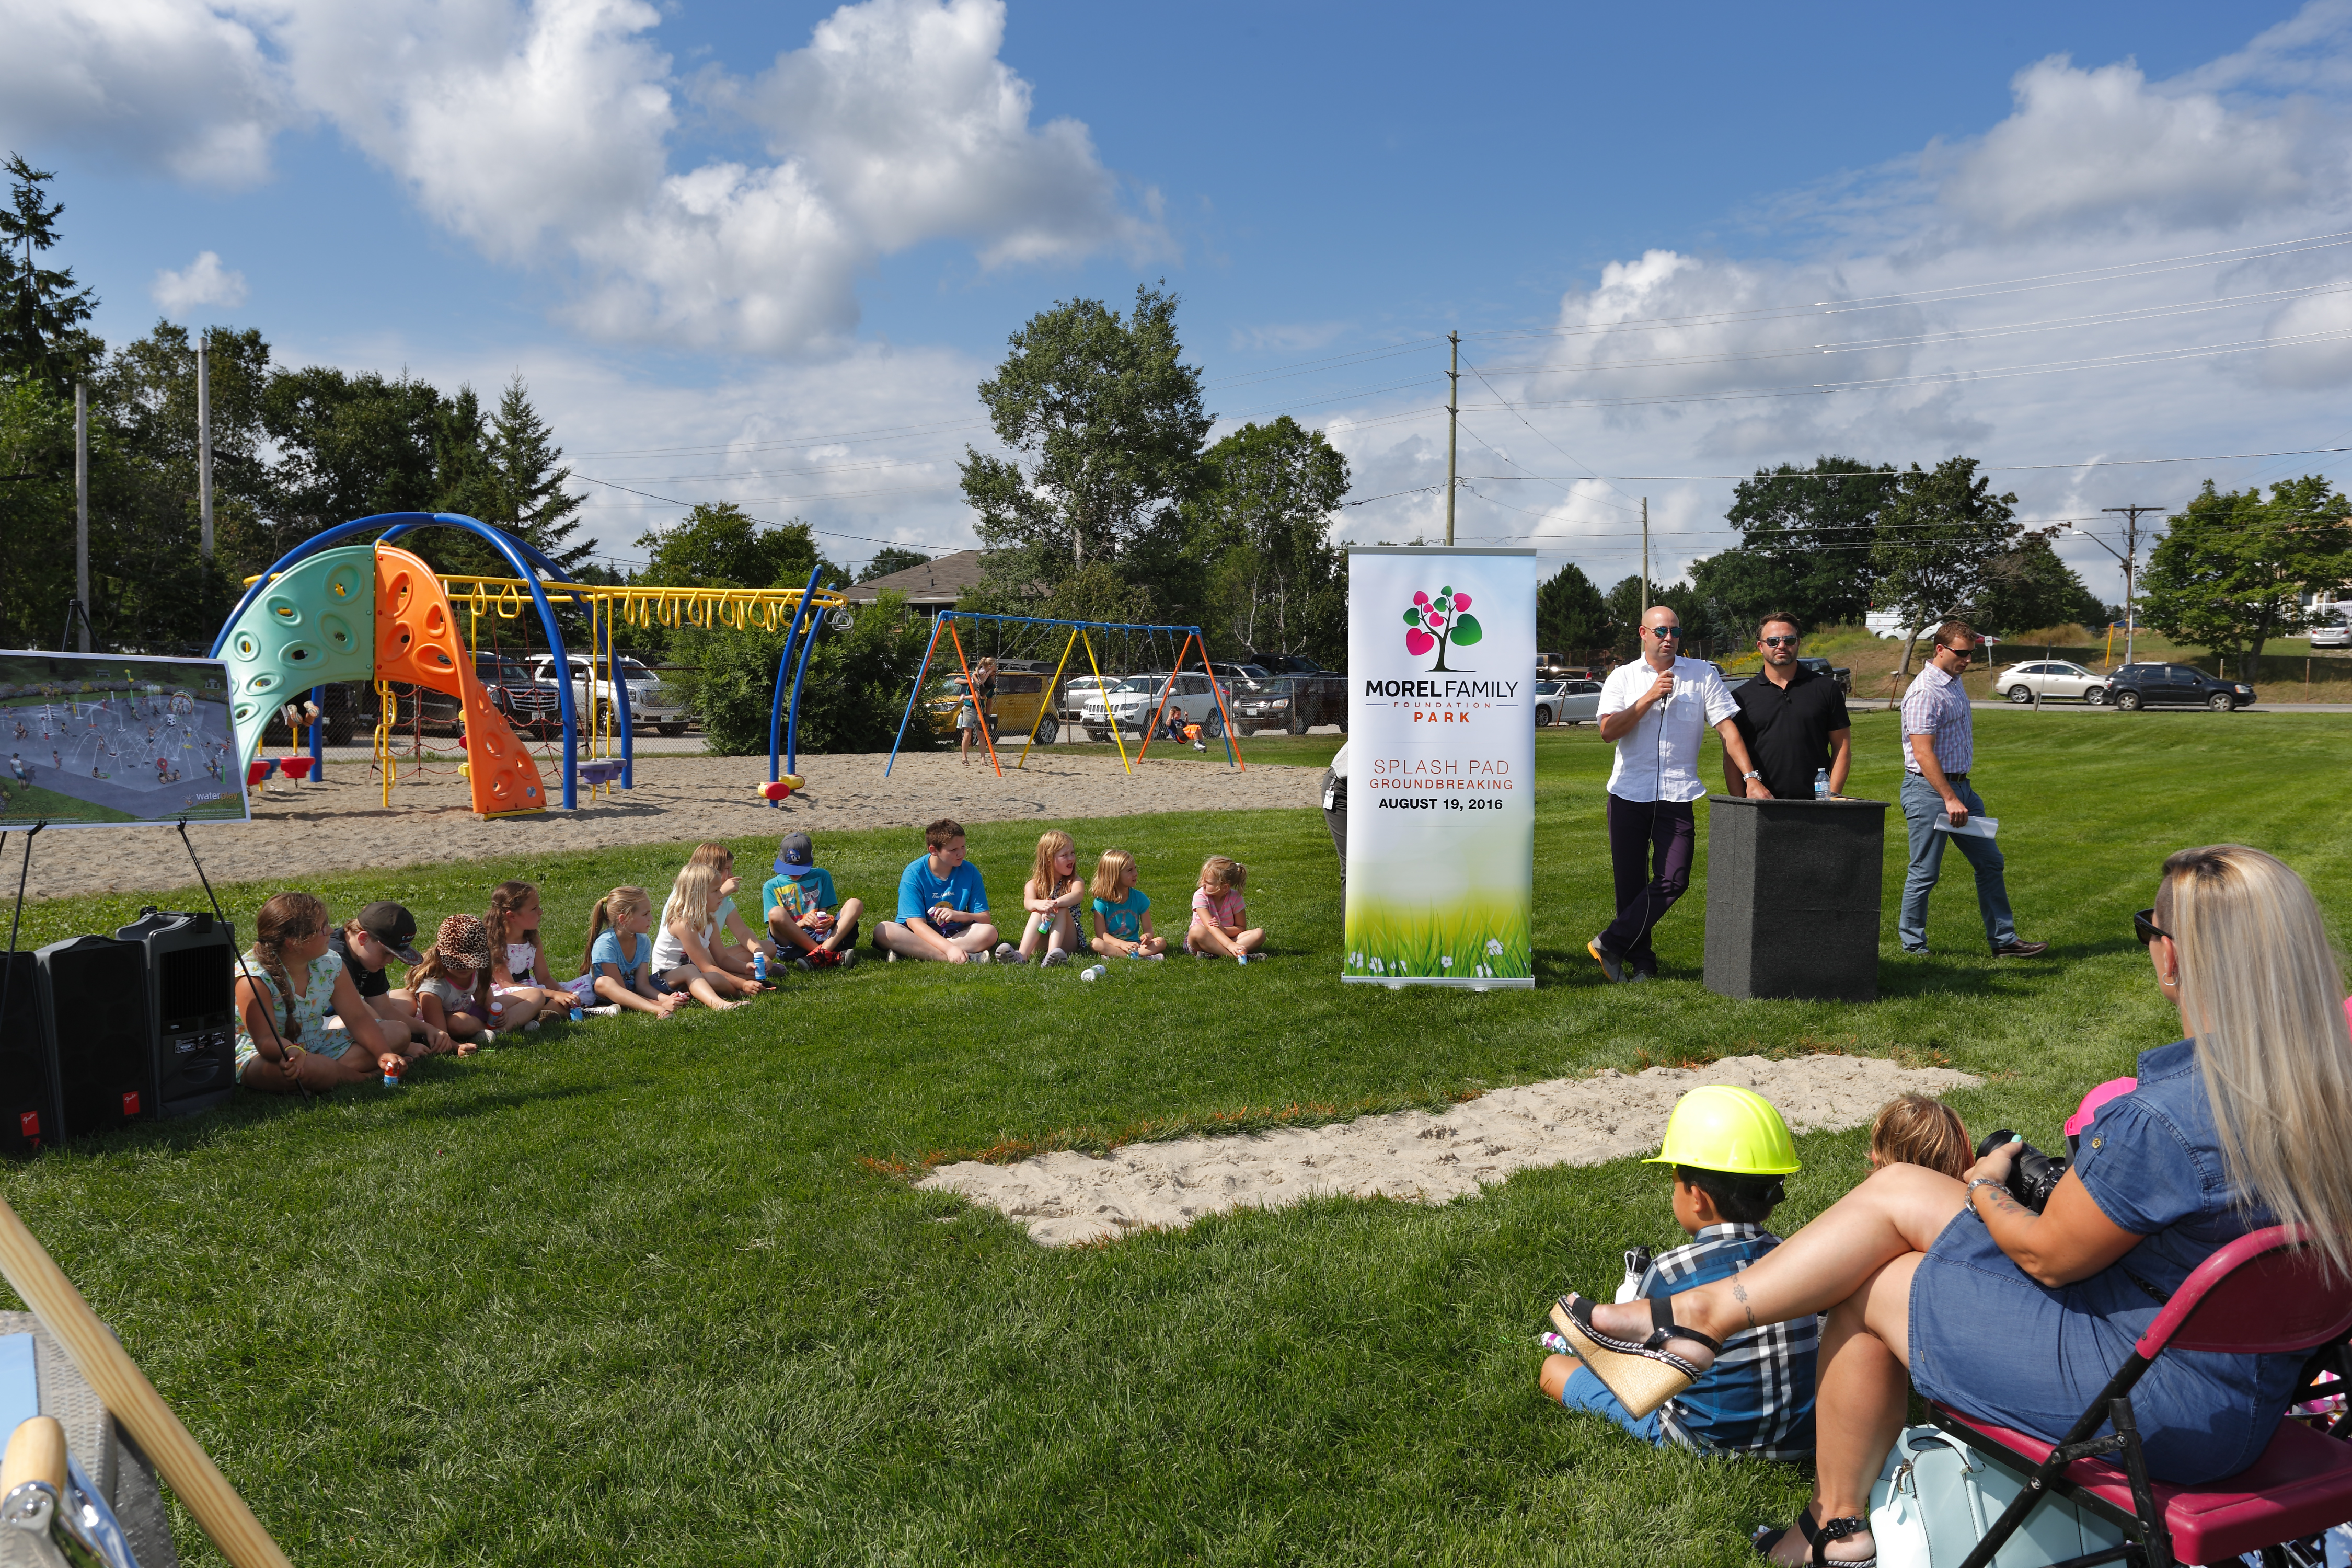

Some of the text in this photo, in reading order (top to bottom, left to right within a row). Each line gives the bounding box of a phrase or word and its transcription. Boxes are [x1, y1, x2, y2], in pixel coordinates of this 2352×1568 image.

[1366, 680, 1519, 698] MOREL FAMILY
[1414, 712, 1470, 723] PARK
[1374, 759, 1509, 775] SPLASH PAD
[1370, 779, 1513, 789] GROUNDBREAKING
[196, 792, 238, 800] waterplay
[1378, 798, 1503, 811] AUGUST 19, 2016
